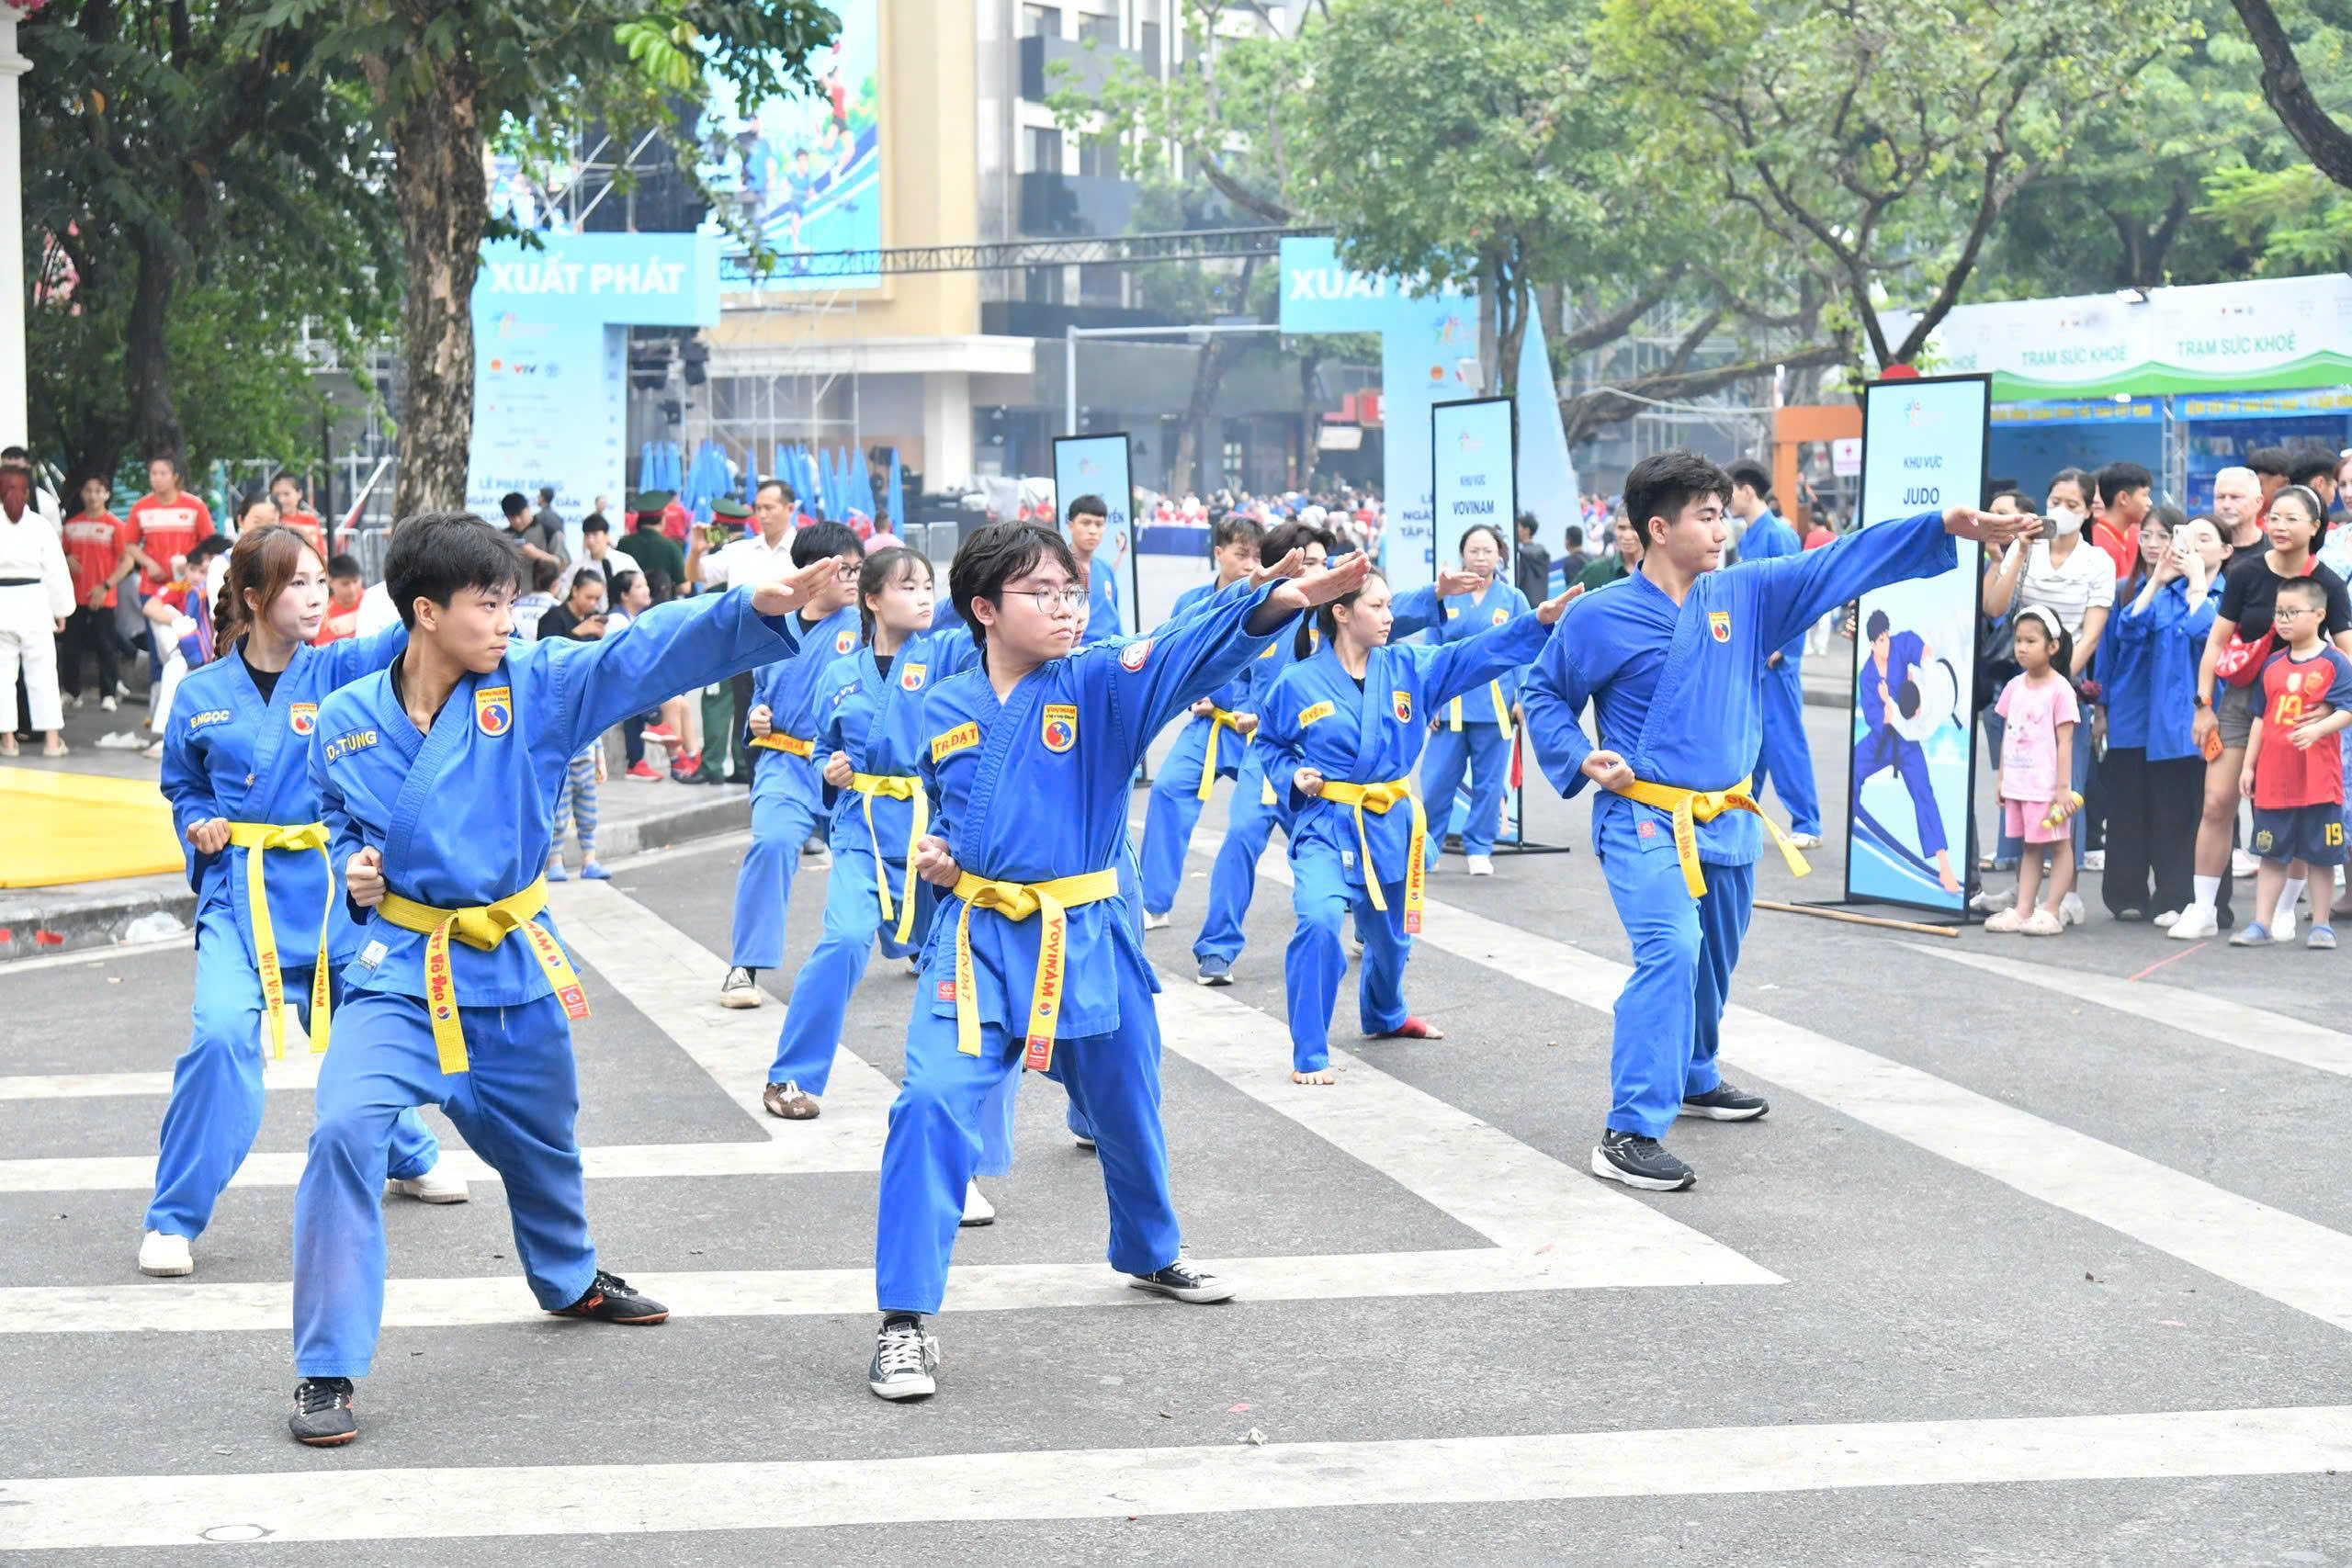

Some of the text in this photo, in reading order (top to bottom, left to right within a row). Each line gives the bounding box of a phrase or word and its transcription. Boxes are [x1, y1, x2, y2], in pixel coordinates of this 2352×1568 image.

[490, 251, 686, 294] XUẤT PHÁT
[1904, 456, 1922, 468] KHU
[1453, 500, 1494, 514] VOVINAM
[1903, 487, 1939, 504] JUDO
[2274, 694, 2302, 727] 19
[2324, 822, 2344, 846] 19
[1411, 835, 1424, 888] VOVINAM
[1042, 918, 1062, 997] VOVINAM
